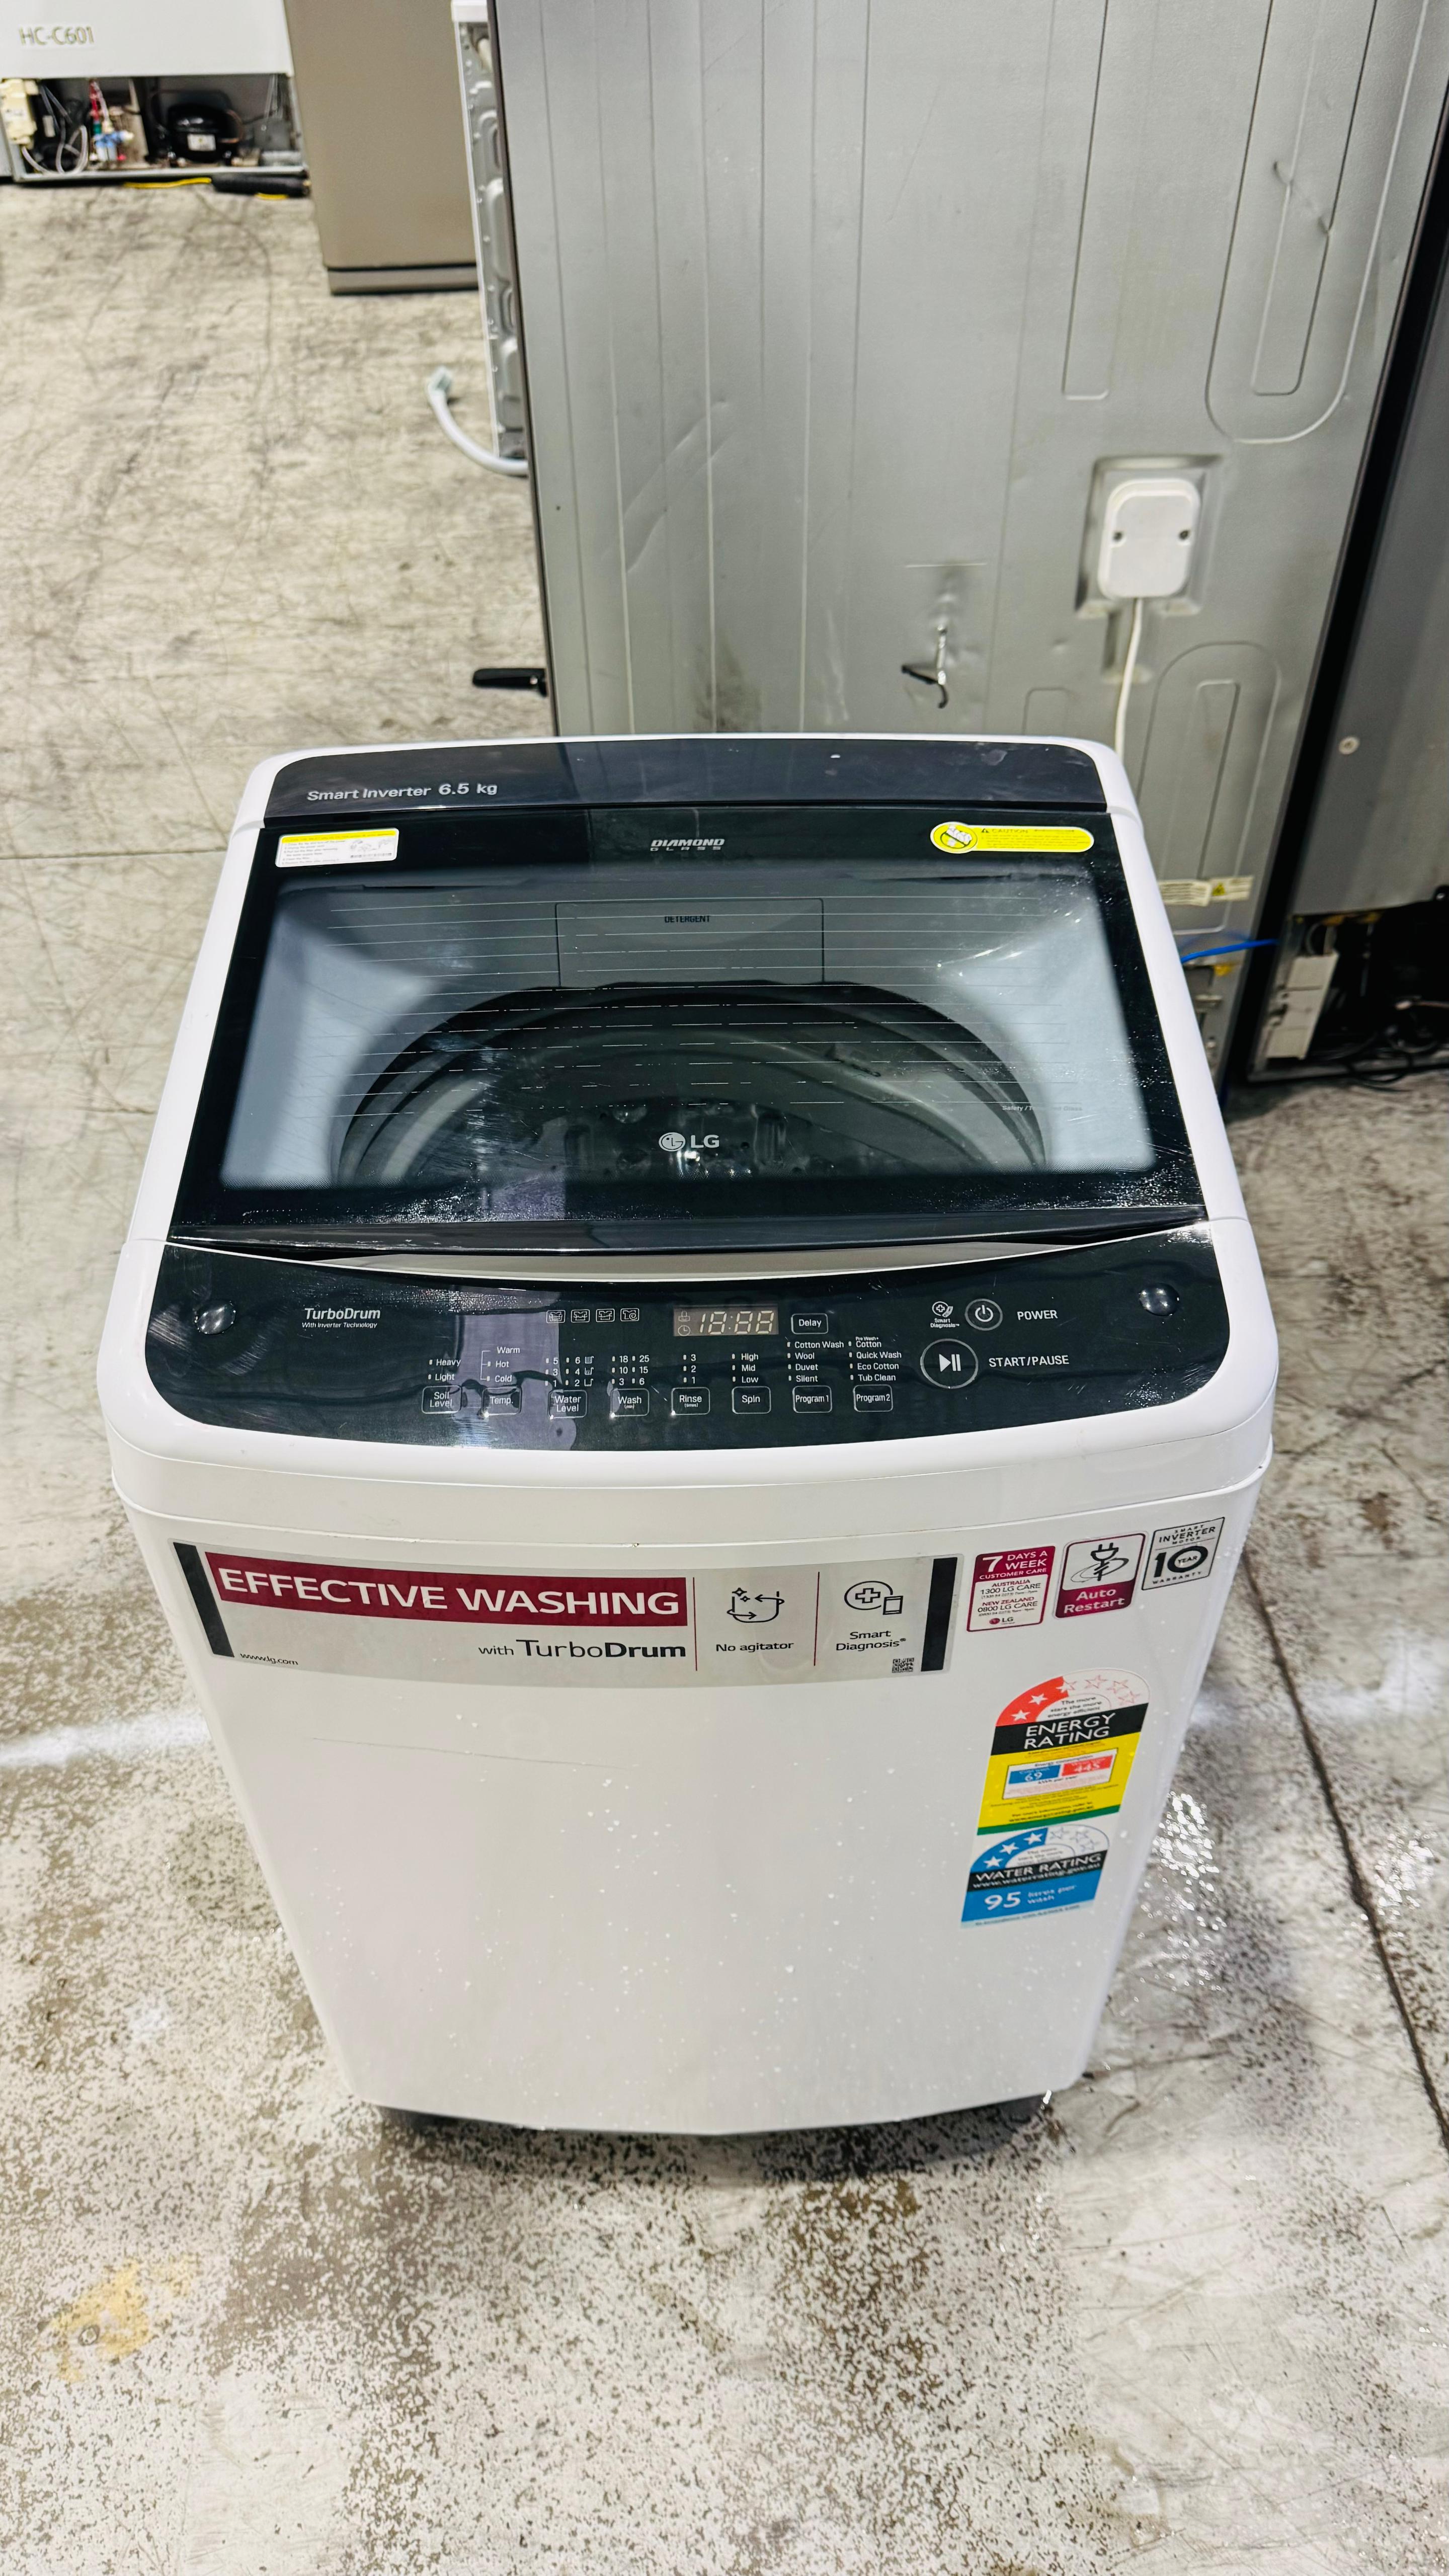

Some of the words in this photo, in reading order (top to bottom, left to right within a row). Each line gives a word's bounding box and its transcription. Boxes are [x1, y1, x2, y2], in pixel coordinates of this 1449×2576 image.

[19, 26, 95, 46] HC-C601
[307, 789, 359, 801] Smart
[363, 787, 431, 798] Inverter
[438, 783, 469, 795] 6.5
[476, 783, 498, 795] kg
[651, 839, 725, 847] DIAMOND
[664, 915, 710, 923] DETERGENT
[690, 1134, 719, 1148] LG
[304, 1308, 381, 1320] TurboDrum
[1017, 1310, 1058, 1321] POWER
[798, 1318, 822, 1327] Delay
[497, 1346, 520, 1354] Warm
[794, 1341, 821, 1349] Cotton
[741, 1353, 759, 1362] High
[856, 1351, 878, 1359] Quick
[436, 1359, 461, 1367] Heavy
[988, 1354, 1070, 1368] START/PAUSE
[435, 1374, 455, 1382] Light
[495, 1374, 512, 1383] Cold
[434, 1392, 449, 1400] Soil
[490, 1396, 514, 1406] Temp.
[554, 1395, 582, 1403] Water
[618, 1396, 641, 1404] Wash
[679, 1395, 702, 1403] Rinse
[741, 1394, 761, 1404] Spin
[795, 1395, 824, 1404] Program
[825, 1395, 829, 1403] 1
[856, 1394, 884, 1403] Program
[430, 1400, 452, 1408] Level
[556, 1404, 579, 1412] Level
[1174, 1524, 1204, 1534] SMART
[1159, 1526, 1216, 1543] INVERTER
[1172, 1536, 1201, 1545] MOTOR
[1007, 1551, 1036, 1561] DAYS
[1177, 1555, 1197, 1564] YEAR
[982, 1556, 1003, 1573] 7
[1005, 1559, 1047, 1570] WEEK
[1153, 1546, 1209, 1578] 10
[979, 1571, 1024, 1580] CUSTOMER
[1152, 1571, 1202, 1584] WARRANTY
[992, 1579, 1030, 1587] AUSTRALIA
[218, 1567, 448, 1609] EFFECTIVE
[456, 1587, 679, 1615] WASHING
[1076, 1588, 1116, 1601] Auto
[1064, 1597, 1125, 1614] Restart
[849, 1630, 892, 1640] Smart
[478, 1645, 514, 1655] with
[516, 1639, 686, 1657] TurboDrum
[716, 1643, 736, 1652] No
[740, 1641, 794, 1653] agitator
[240, 1653, 298, 1665] www.lg.com
[1026, 1713, 1116, 1737] ENERGY
[1023, 1726, 1110, 1750] RATING
[1025, 1772, 1042, 1782] 69
[976, 1865, 1033, 1882] WATER
[1038, 1853, 1102, 1873] RATING
[984, 1891, 1021, 1911] 95
